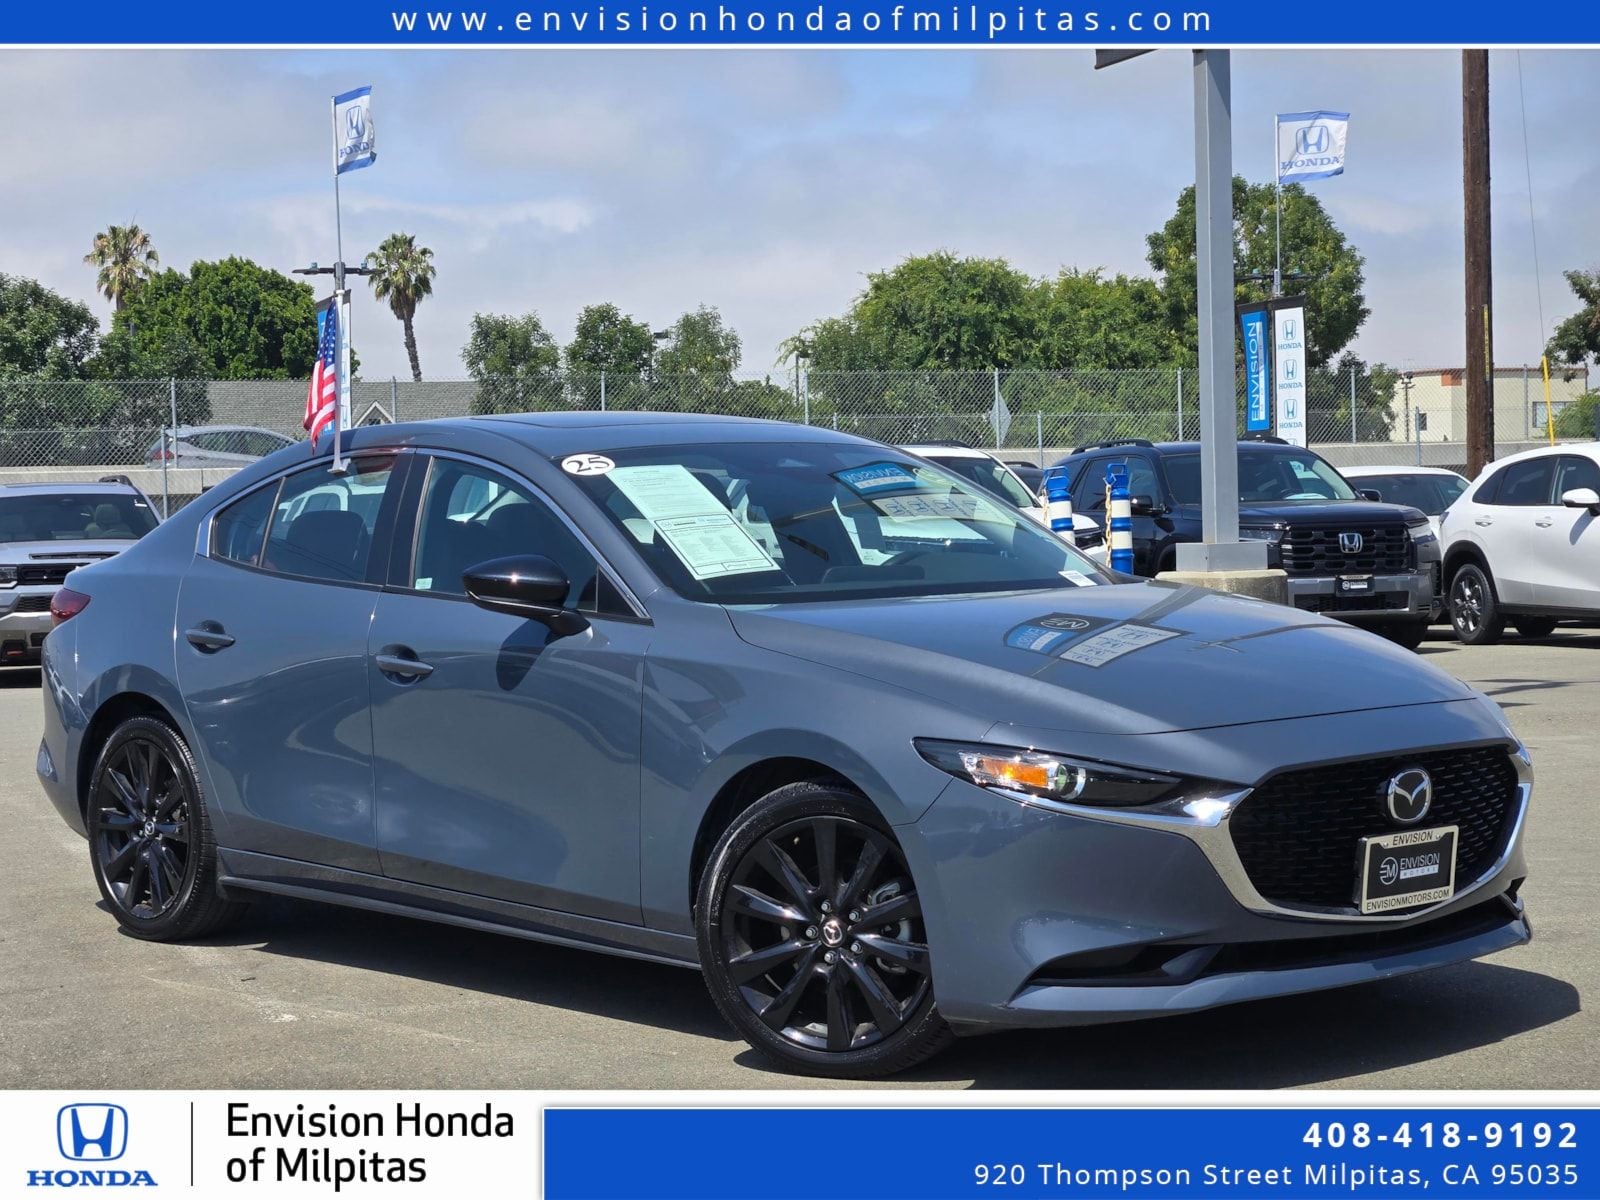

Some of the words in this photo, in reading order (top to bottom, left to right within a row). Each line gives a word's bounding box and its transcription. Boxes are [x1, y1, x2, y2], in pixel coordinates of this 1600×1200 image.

[1281, 156, 1340, 170] HONDA
[1278, 342, 1303, 350] HONDA
[1247, 321, 1260, 422] ENVISION
[1278, 382, 1303, 390] HONDA
[1278, 421, 1303, 429] HONDA
[566, 456, 610, 473] 25
[1392, 831, 1434, 846] ENVISION
[1400, 853, 1441, 870] ENVISION
[1366, 889, 1450, 911] ENVISIONMOTORS.COM
